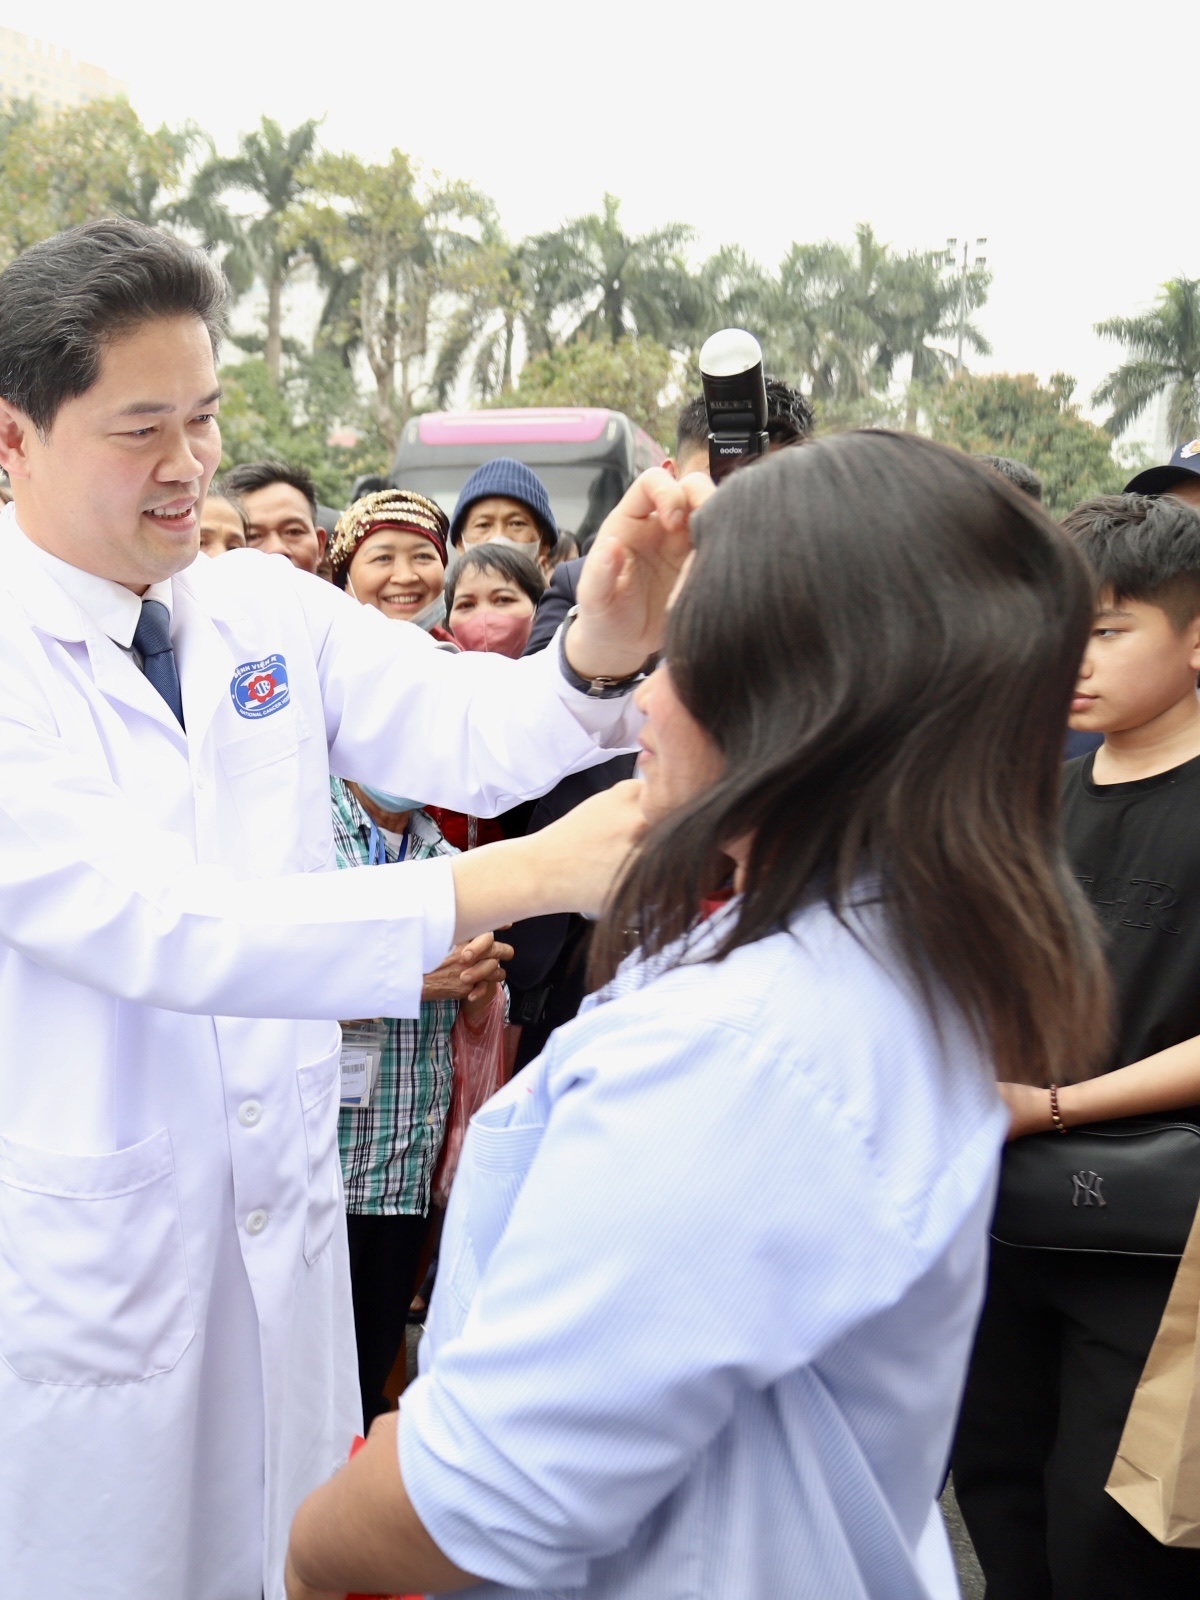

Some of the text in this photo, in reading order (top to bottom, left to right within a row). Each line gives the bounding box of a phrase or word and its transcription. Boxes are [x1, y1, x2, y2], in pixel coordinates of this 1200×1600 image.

[251, 659, 270, 670] VIỆN
[239, 708, 262, 717] NATIONAL
[262, 702, 282, 715] CANCER
